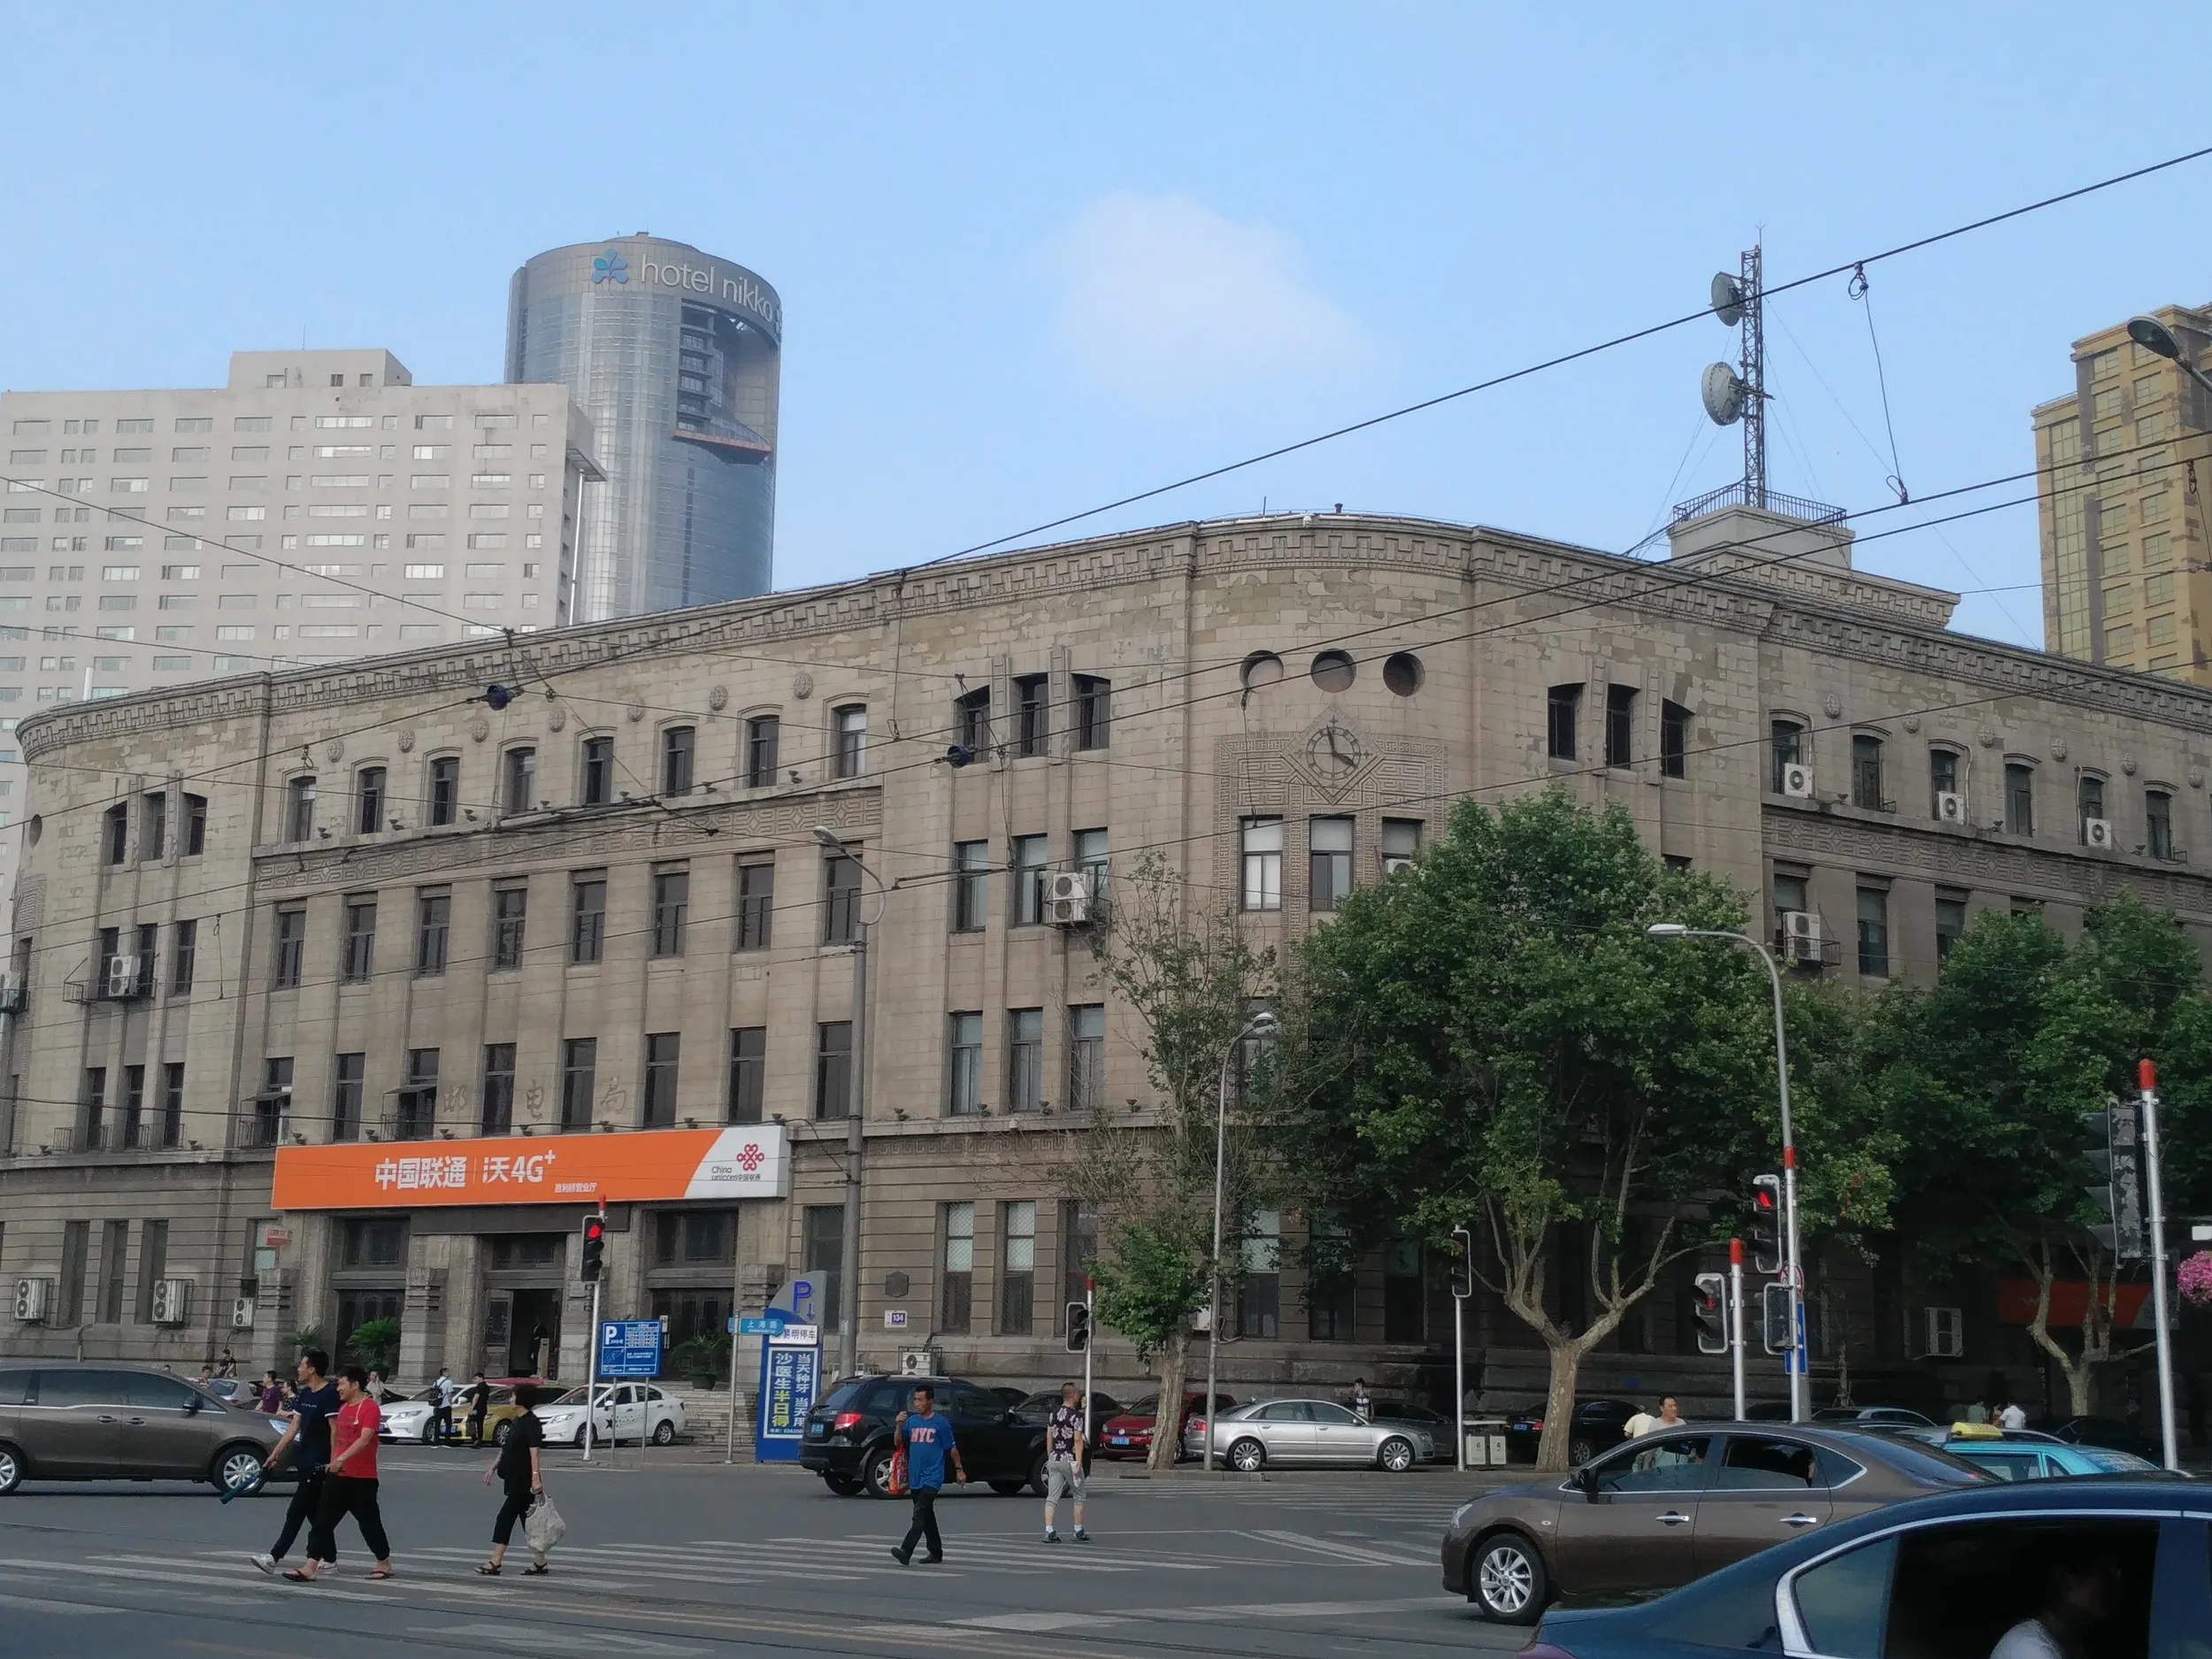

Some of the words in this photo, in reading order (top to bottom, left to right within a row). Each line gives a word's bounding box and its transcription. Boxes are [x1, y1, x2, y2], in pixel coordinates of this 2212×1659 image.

[641, 253, 716, 294] hotel
[722, 276, 773, 323] nikko
[375, 1156, 467, 1190] 中国联通
[711, 1165, 733, 1174] China
[793, 1279, 813, 1313] P
[605, 1325, 618, 1345] P
[910, 1427, 936, 1443] NYC
